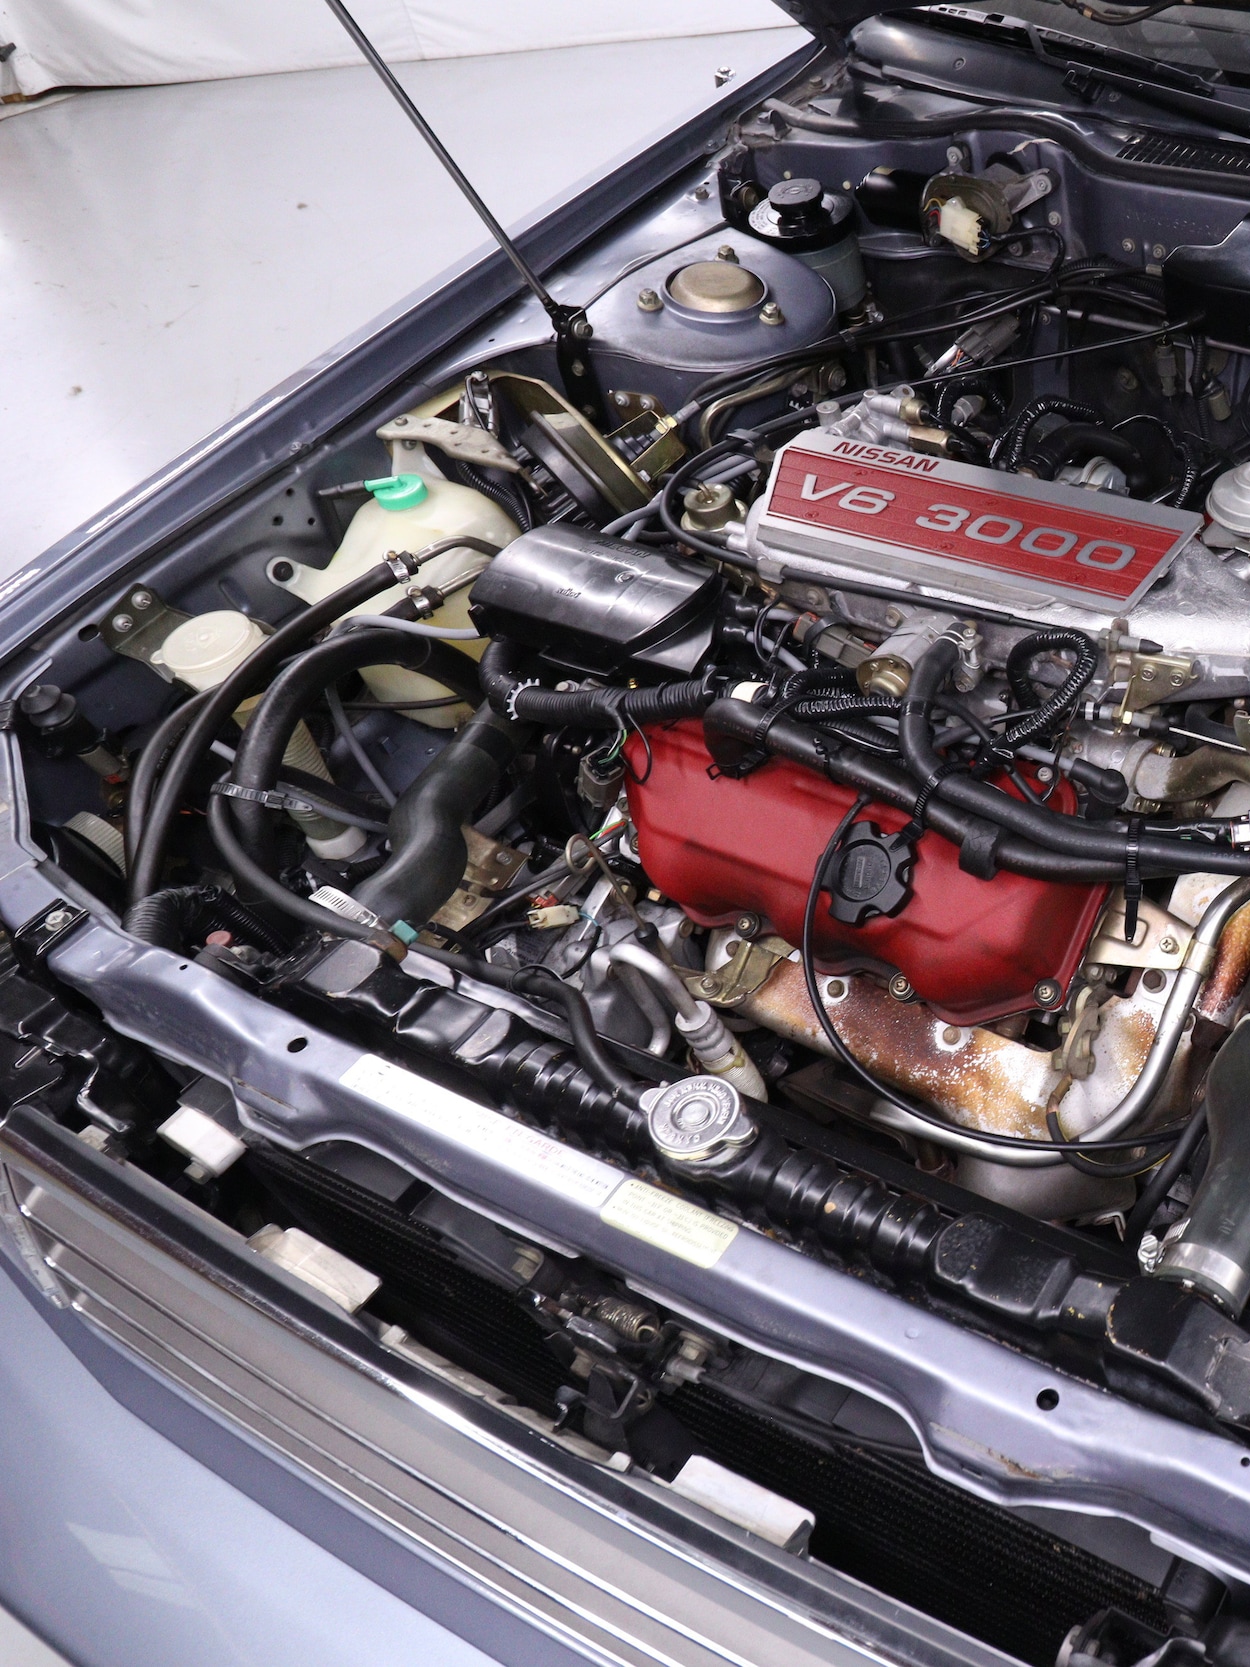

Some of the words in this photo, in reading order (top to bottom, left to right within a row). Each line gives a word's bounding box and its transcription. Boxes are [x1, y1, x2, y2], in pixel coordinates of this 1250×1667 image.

[833, 442, 939, 472] NISSAN
[800, 474, 896, 514] V6
[916, 505, 1136, 571] 3000
